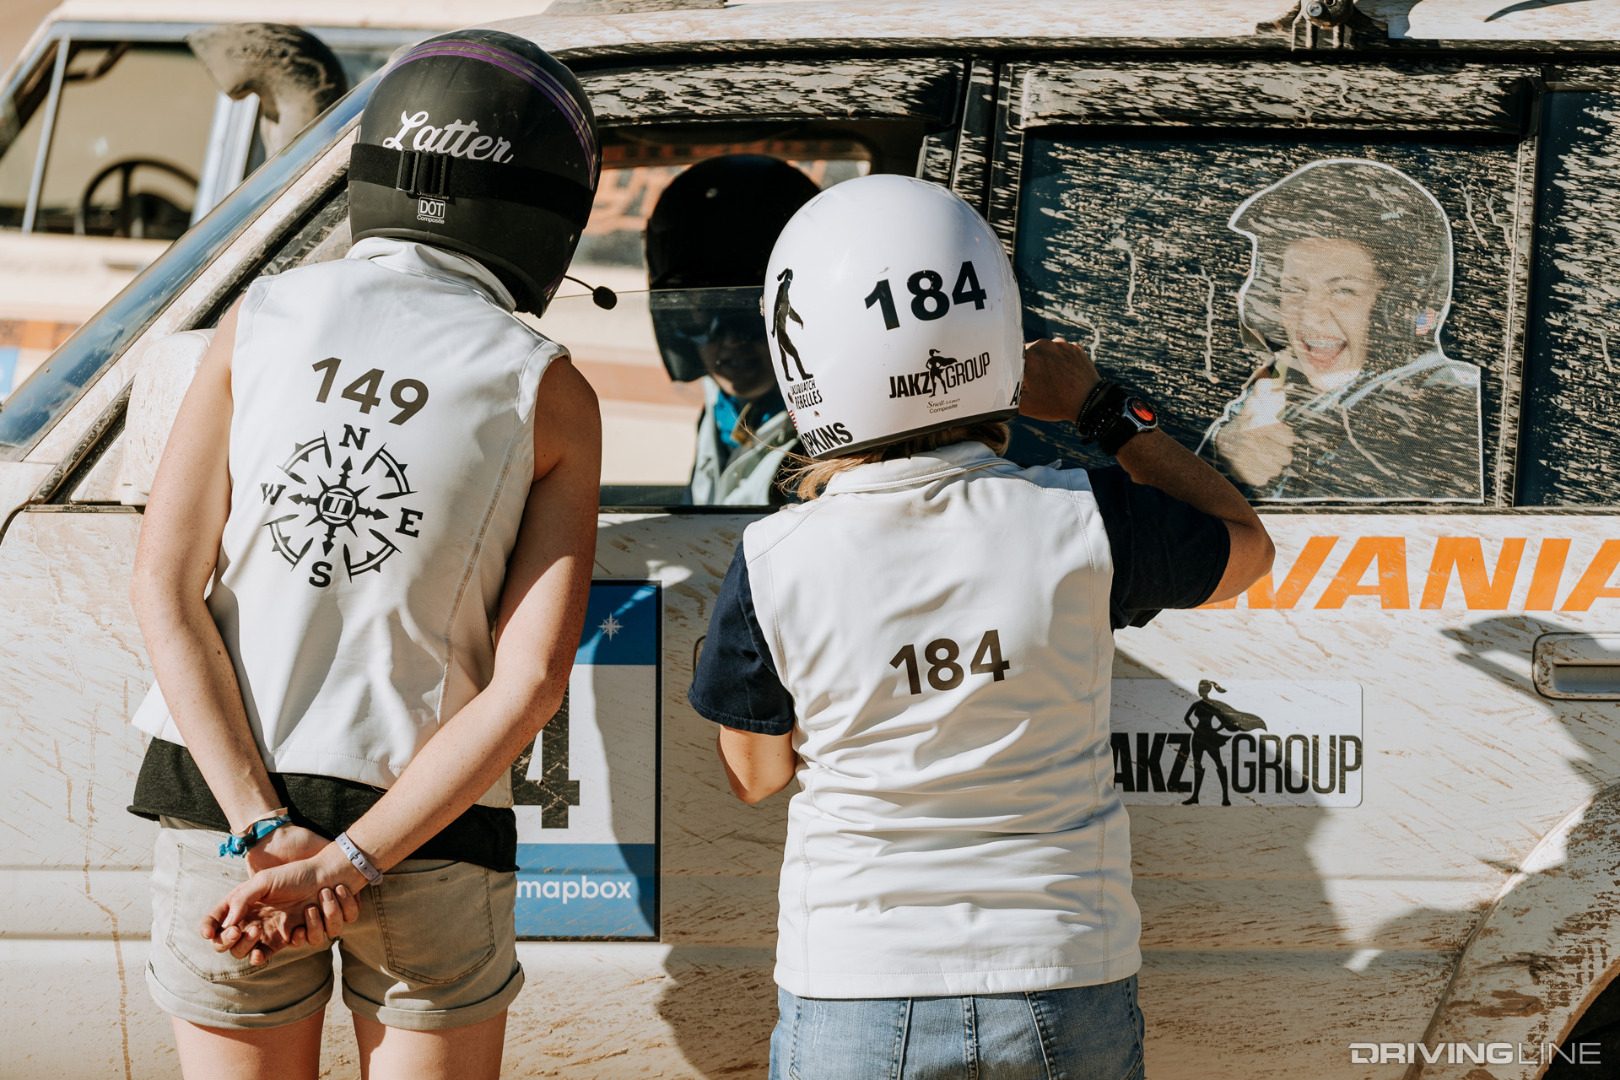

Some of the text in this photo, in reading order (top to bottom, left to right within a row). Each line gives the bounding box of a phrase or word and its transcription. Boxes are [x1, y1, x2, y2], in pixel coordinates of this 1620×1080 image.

[383, 111, 514, 164] Latter
[417, 214, 445, 225] Composite
[420, 200, 444, 217] DOT
[864, 261, 987, 331] 184
[312, 357, 429, 426] 149
[889, 352, 990, 398] JAKZ GROUP
[339, 424, 370, 450] N
[260, 483, 286, 505] W
[395, 507, 423, 538] E
[309, 561, 333, 588] S
[1190, 536, 1620, 612] VANIA
[890, 629, 1010, 695] 184
[1231, 733, 1363, 794] GROUP
[517, 875, 632, 904] mapbox
